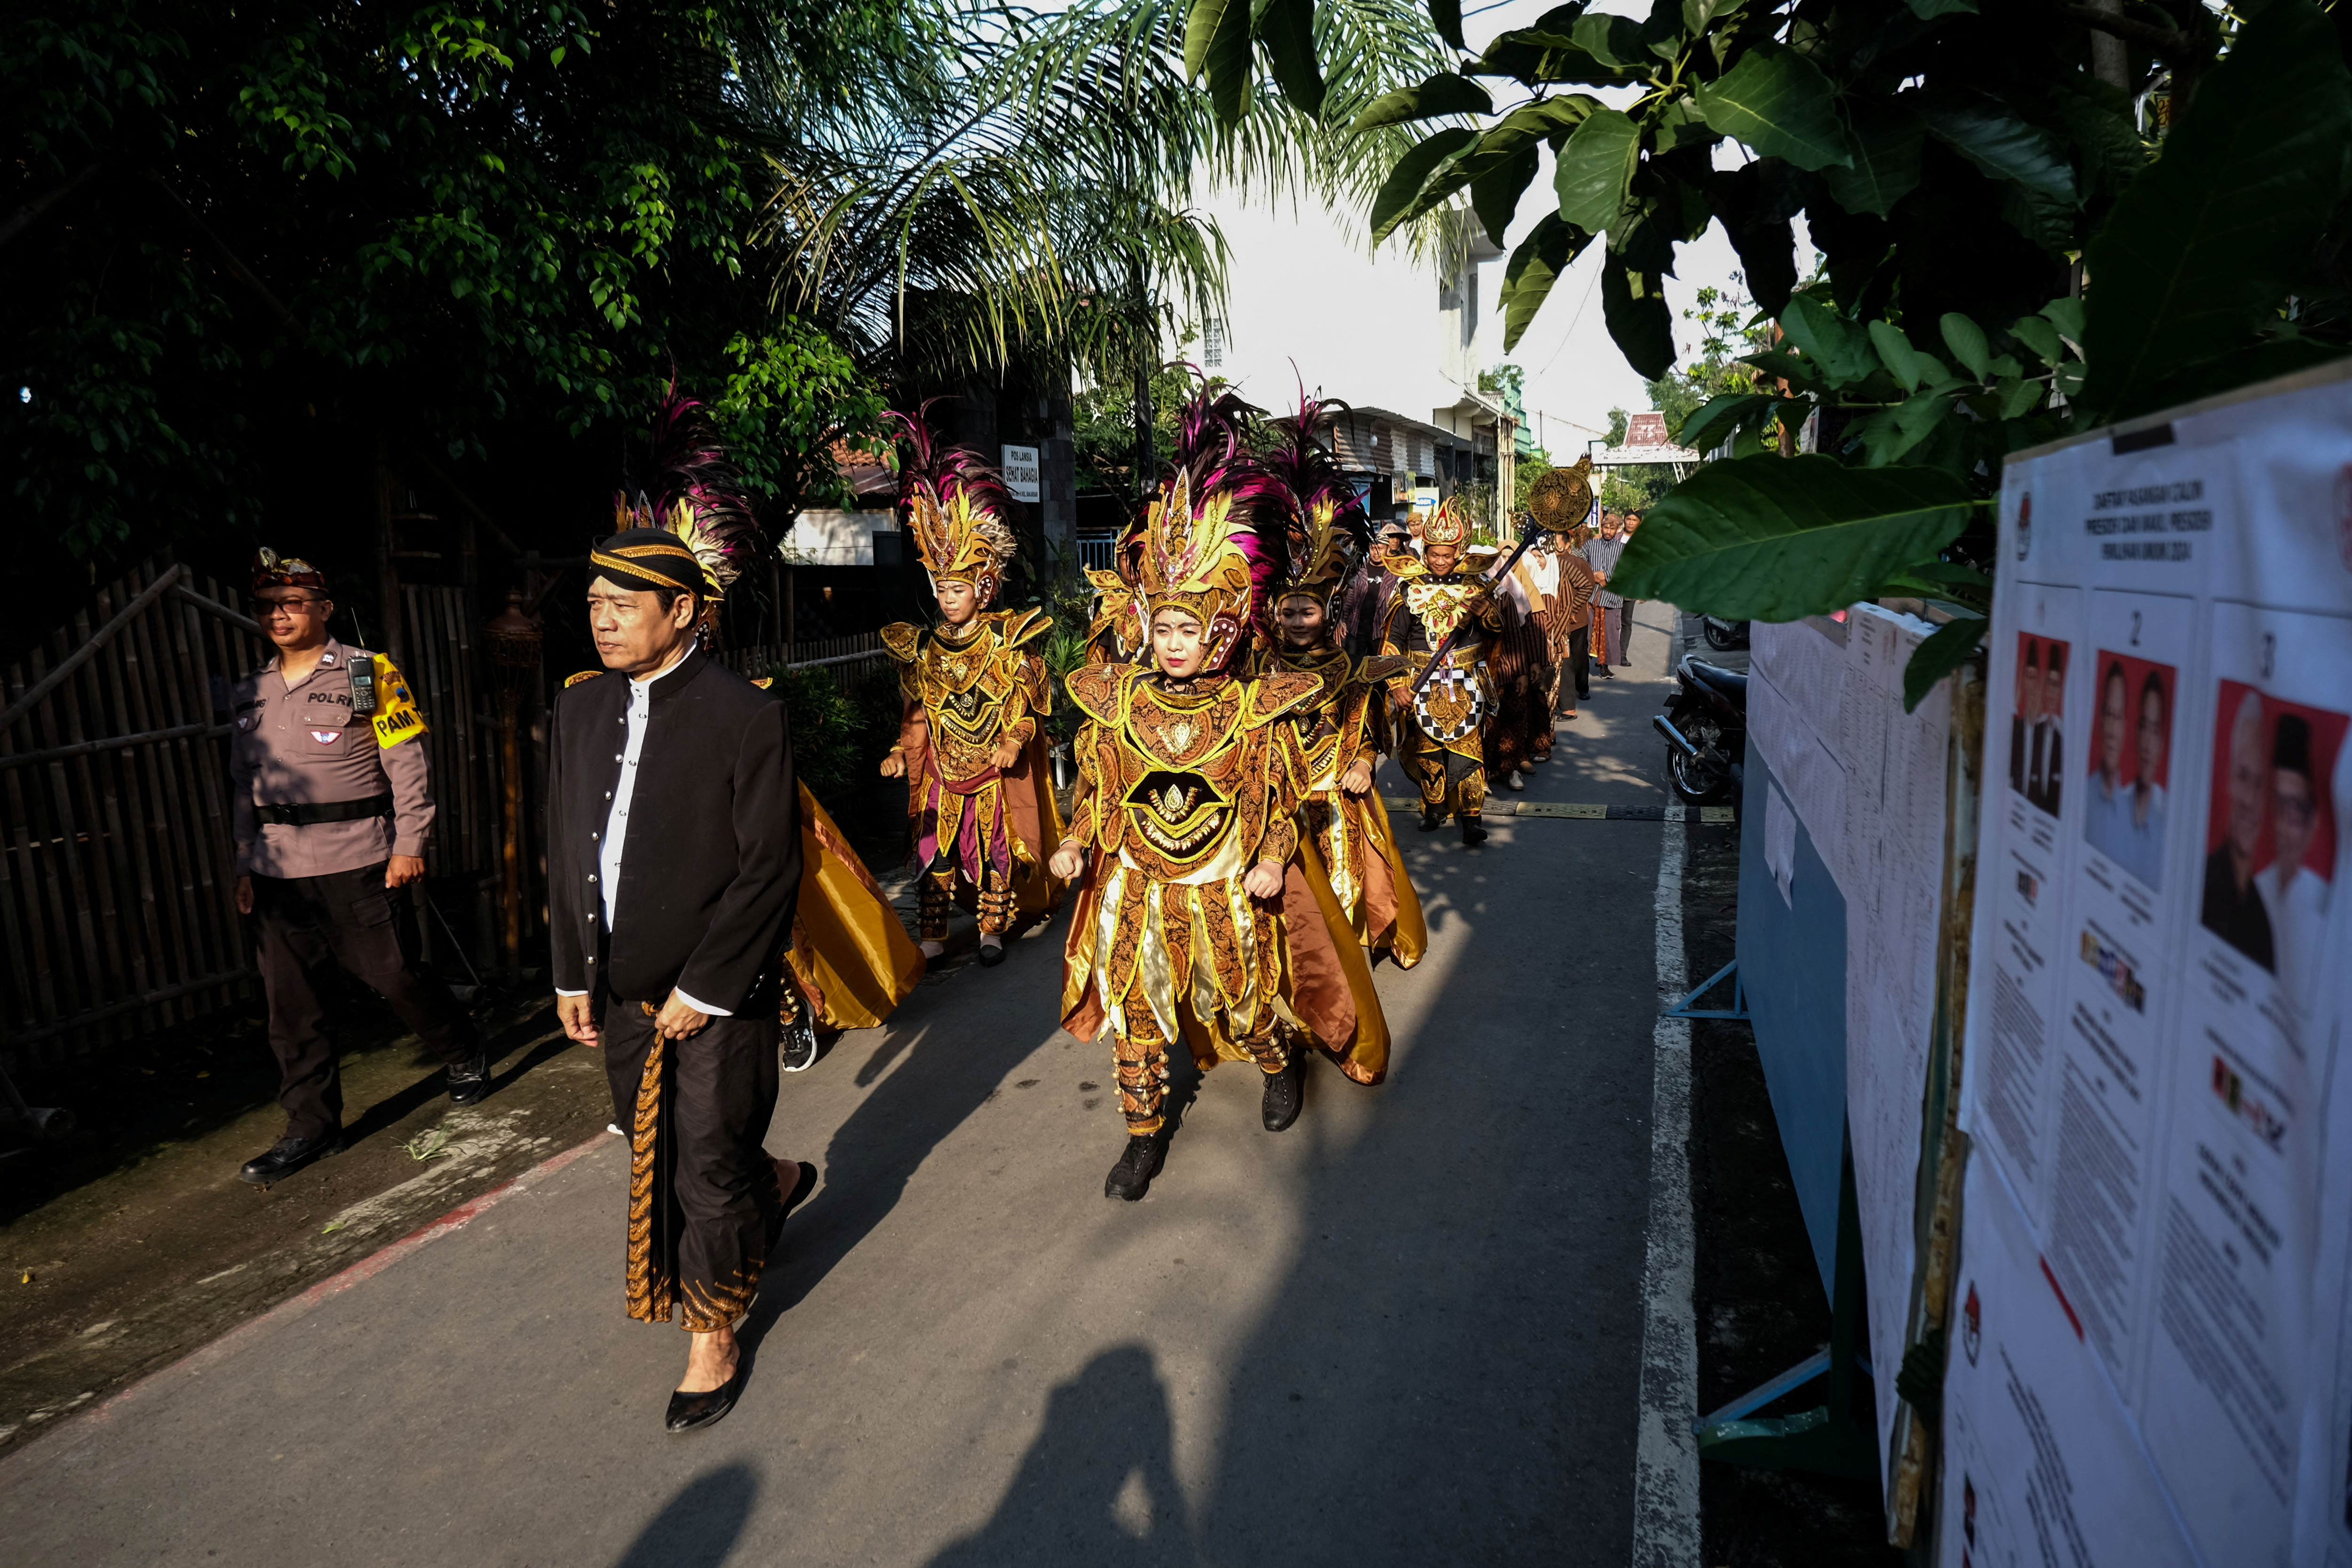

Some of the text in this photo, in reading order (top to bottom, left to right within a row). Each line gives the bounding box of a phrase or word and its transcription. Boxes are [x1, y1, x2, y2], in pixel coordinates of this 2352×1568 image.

[1019, 452, 1033, 462] LANSIA
[1006, 465, 1038, 484] SEHAT BAHAGIA
[2129, 609, 2141, 647] 2
[2260, 630, 2276, 679] 3
[307, 692, 352, 707] POLRI
[376, 710, 415, 738] PAM
